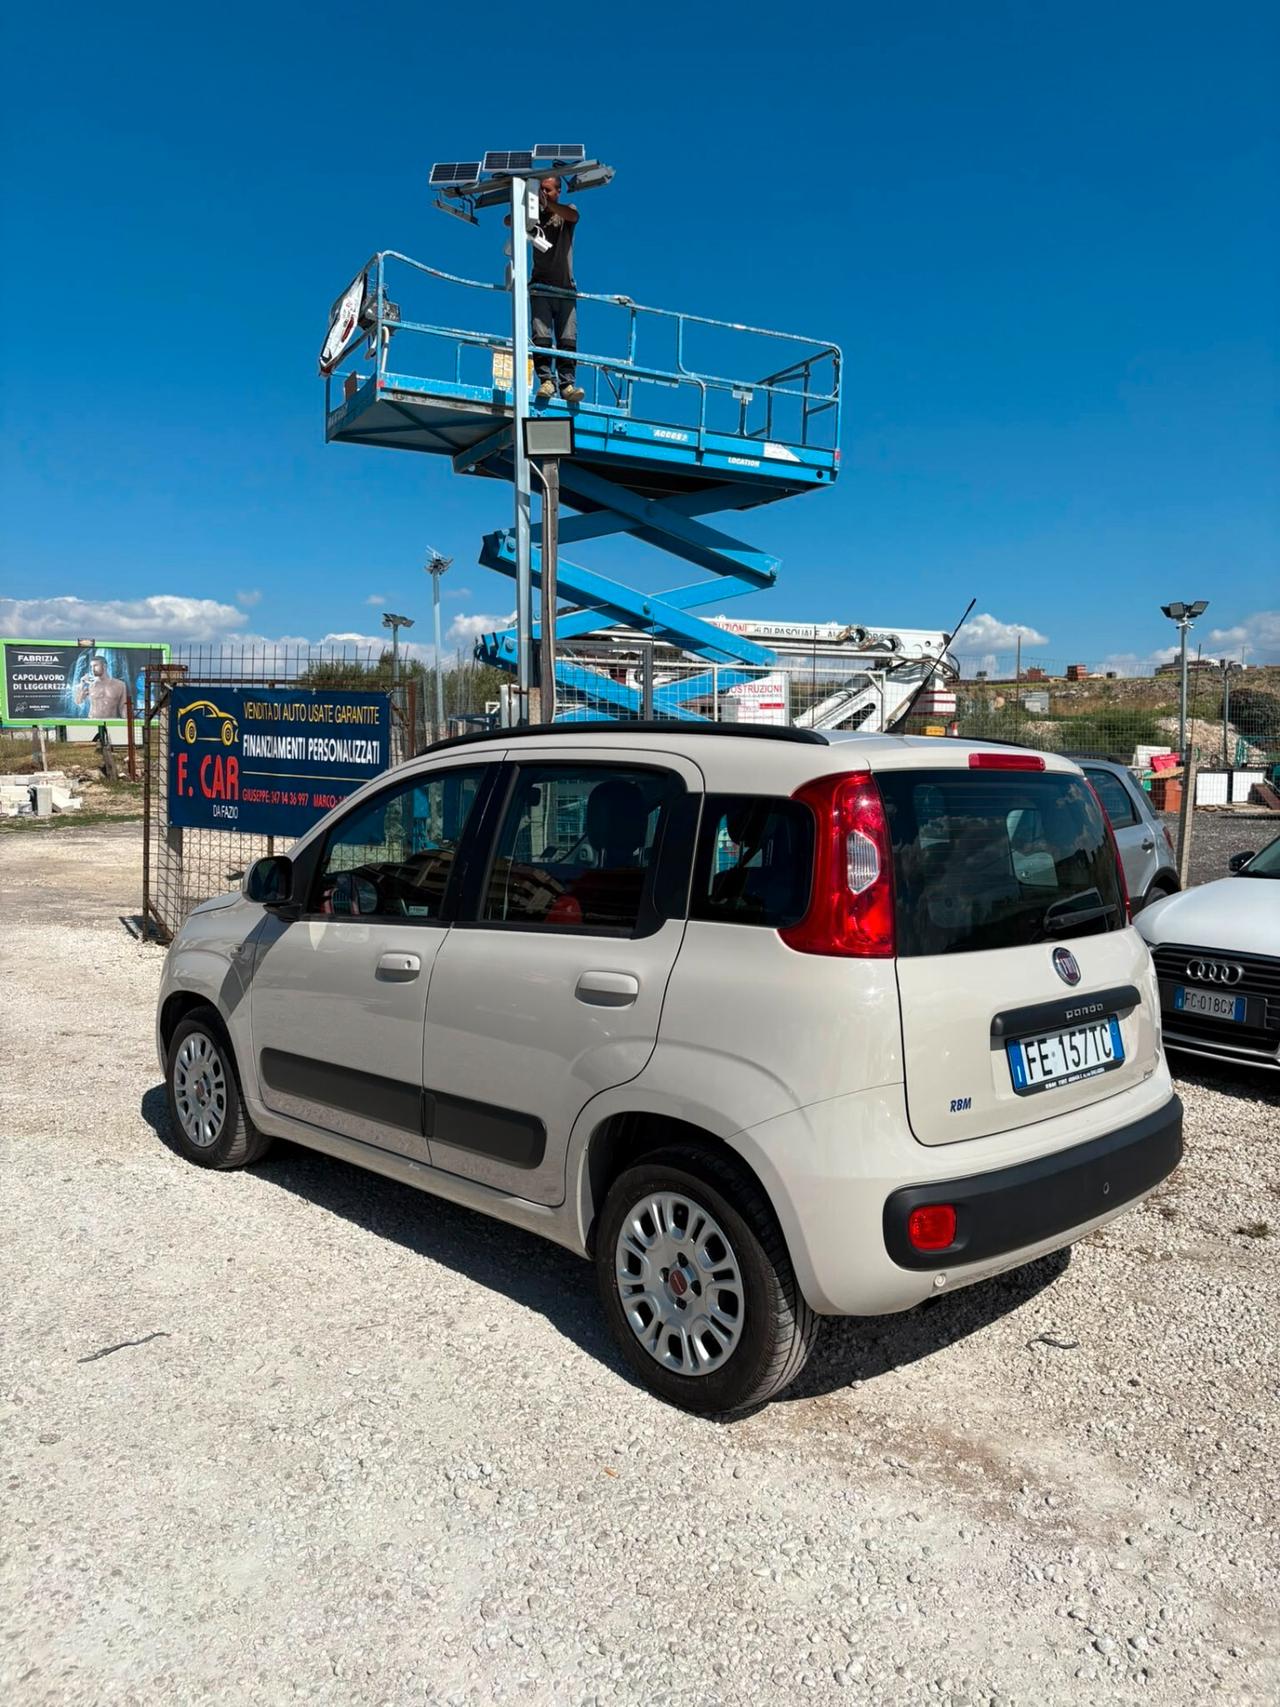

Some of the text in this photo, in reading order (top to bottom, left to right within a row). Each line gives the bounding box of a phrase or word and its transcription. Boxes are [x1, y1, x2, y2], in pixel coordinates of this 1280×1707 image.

[24, 683, 71, 691] LEGGEREZZA
[243, 702, 380, 725] VENDITA DI AUTO USATE GARANTITE
[243, 734, 380, 765] FINANZIAMENTI PERSONALIZZATI
[177, 752, 239, 800] F. CAR
[212, 804, 239, 819] DA FAZIO
[949, 1096, 972, 1113] RBM
